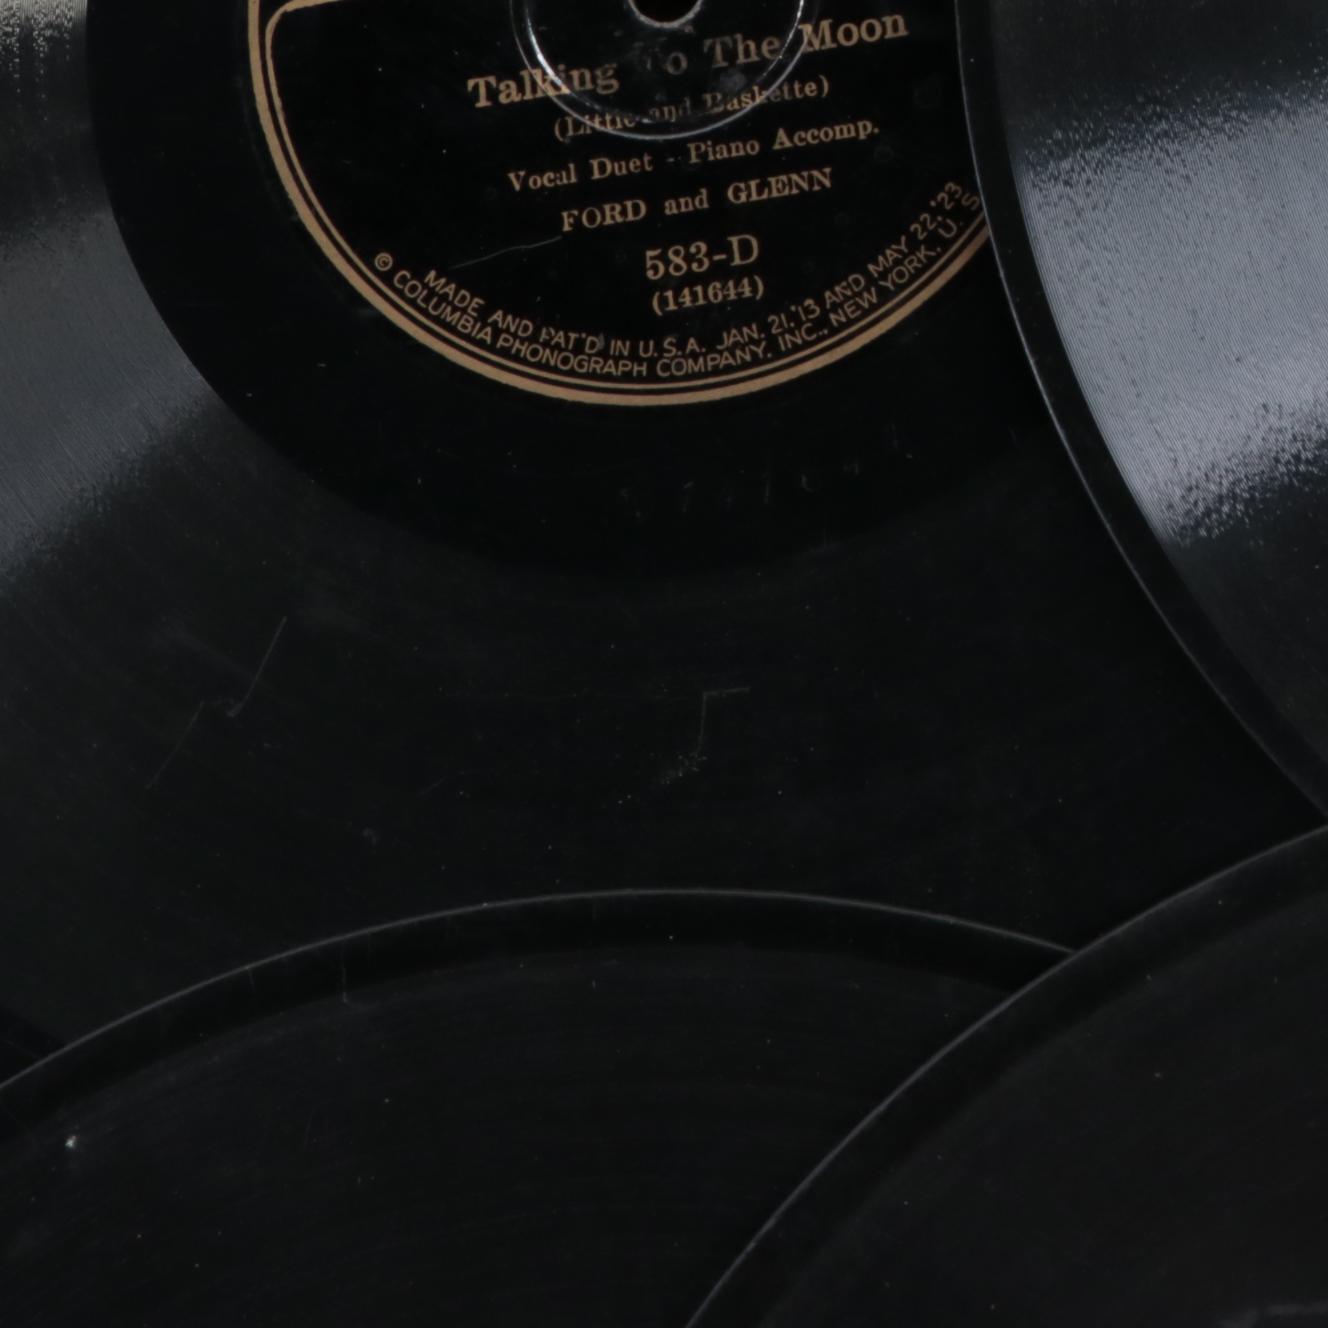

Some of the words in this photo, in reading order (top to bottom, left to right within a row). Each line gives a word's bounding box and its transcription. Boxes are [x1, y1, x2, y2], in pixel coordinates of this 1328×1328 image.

[467, 63, 621, 109] Talking
[703, 30, 782, 69] The
[798, 13, 909, 53] Moon
[508, 164, 578, 193] Vocal
[589, 155, 654, 180] Duet
[687, 138, 760, 165] Piano
[772, 118, 880, 151] Accomp.
[561, 199, 647, 233] FORD
[664, 189, 710, 217] and
[727, 167, 833, 205] GLENN
[645, 233, 760, 281] 583-D
[392, 269, 493, 345] COLUMBIA
[496, 332, 648, 378] PHONOGRAPH
[829, 287, 880, 327] NEW
[424, 269, 485, 317] MADE
[487, 309, 534, 338] AND
[609, 338, 631, 356] IN
[716, 323, 766, 352] JAN.
[823, 273, 867, 309] AND
[867, 234, 910, 279] MAY
[652, 275, 765, 316] (141644)
